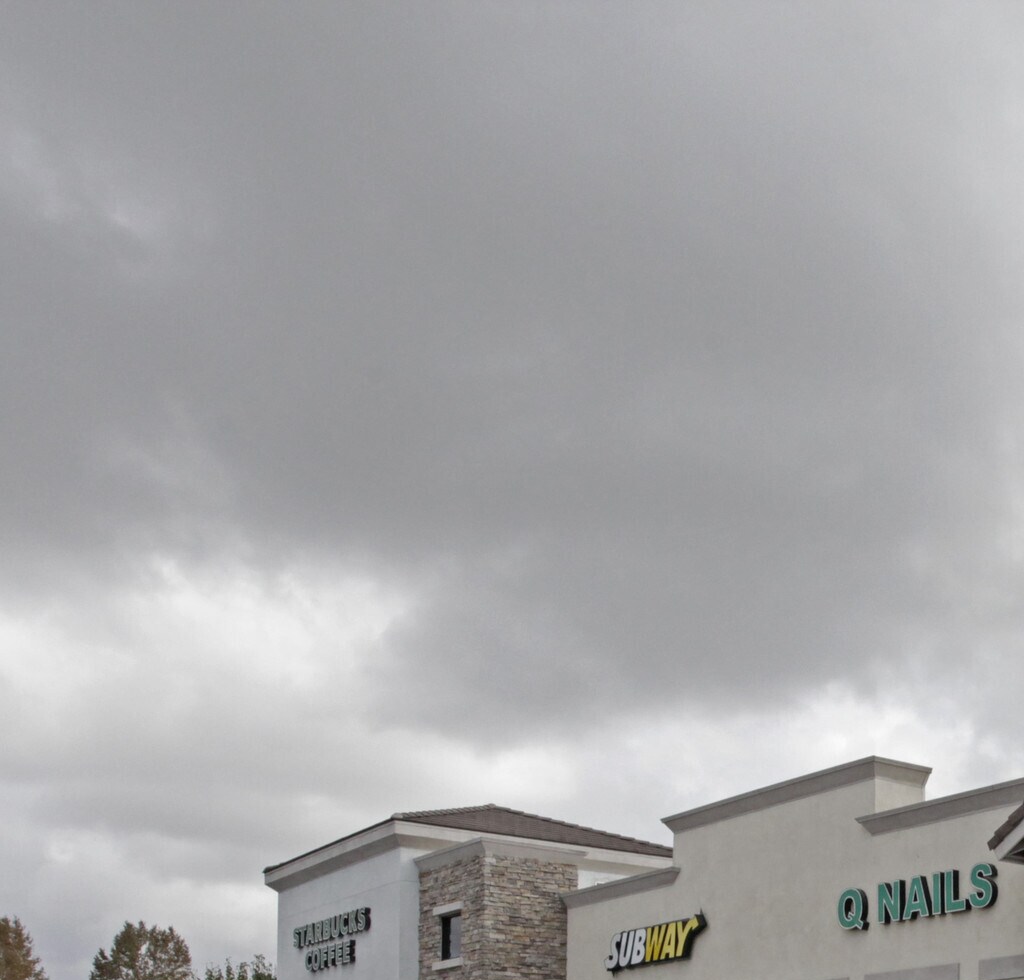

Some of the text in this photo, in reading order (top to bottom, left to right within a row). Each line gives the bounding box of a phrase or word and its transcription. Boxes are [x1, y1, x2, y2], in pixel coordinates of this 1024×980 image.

[838, 863, 998, 930] Q NAILS
[293, 907, 371, 949] STARBUCKS
[604, 912, 707, 973] SUBWAY
[305, 940, 356, 972] COFFEE
